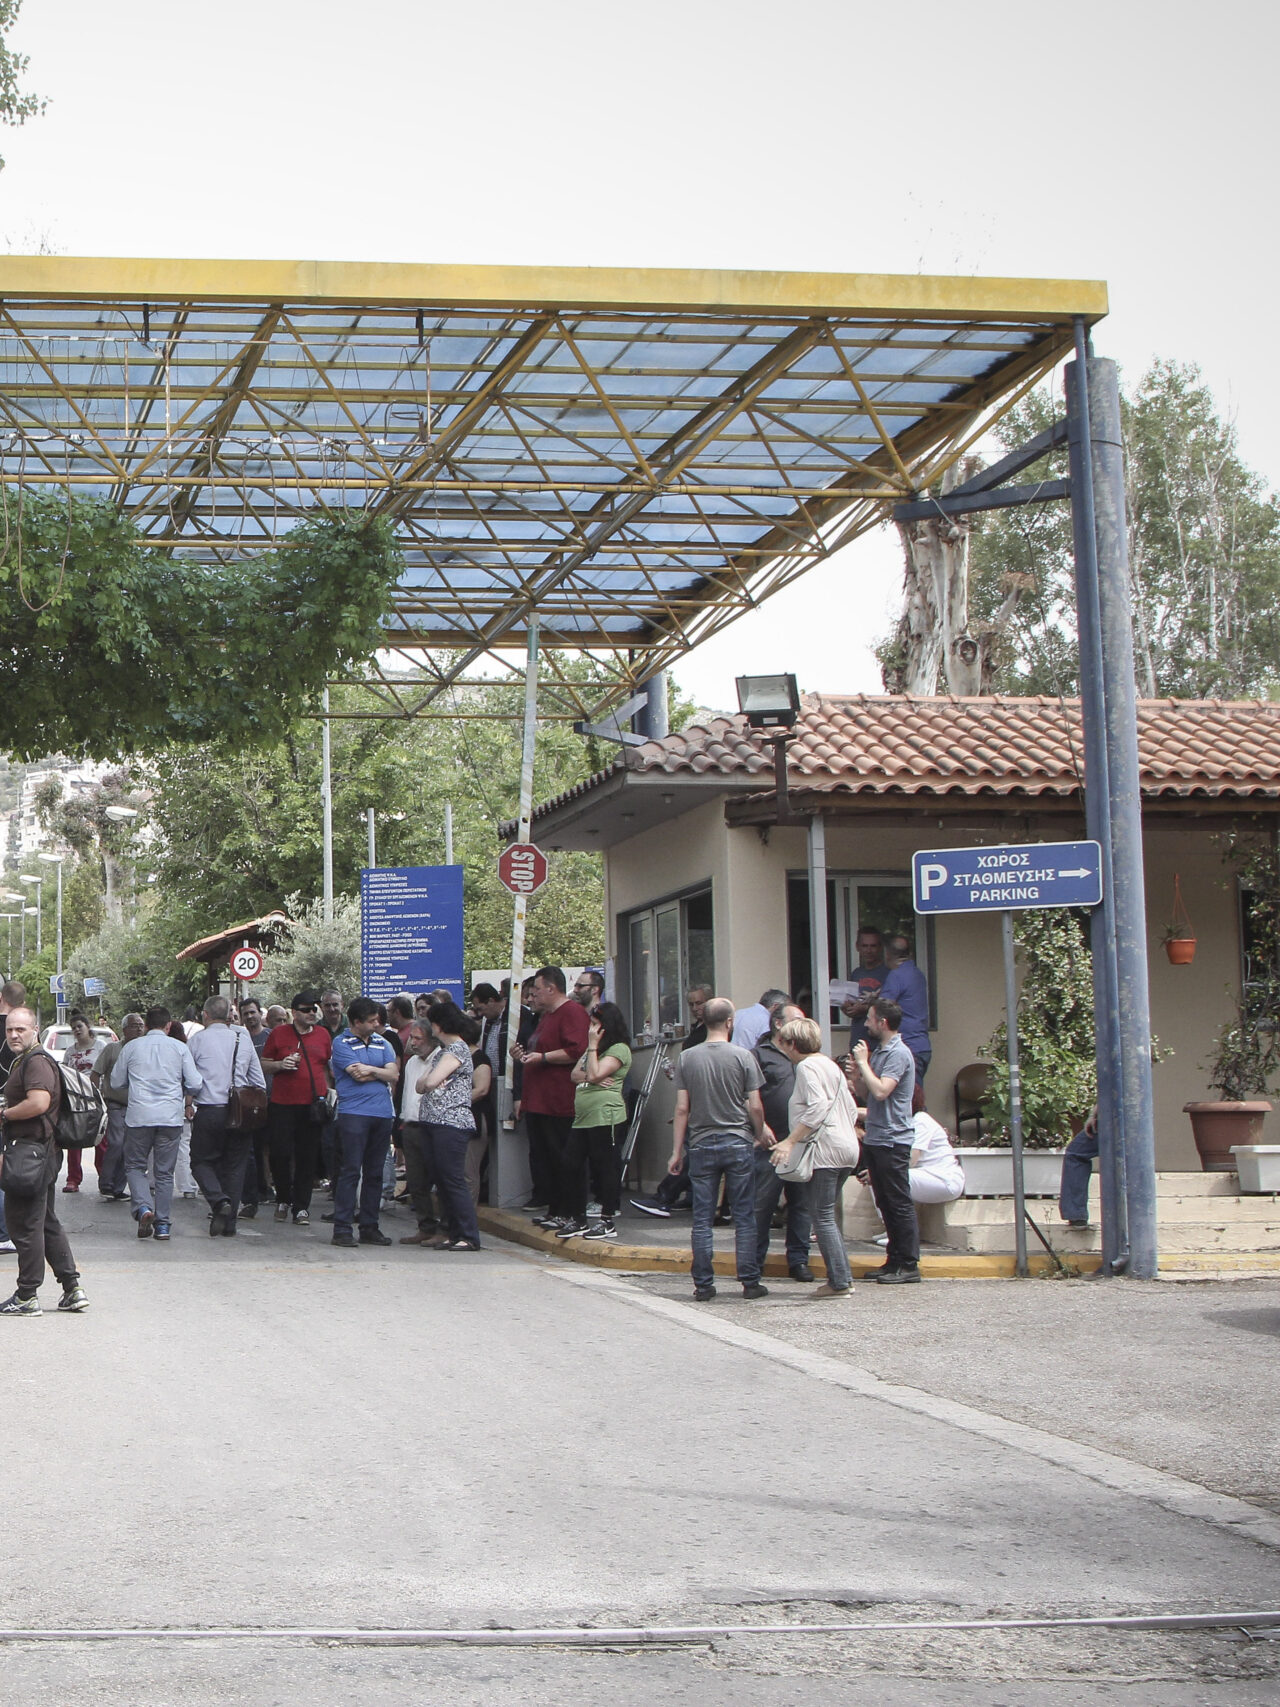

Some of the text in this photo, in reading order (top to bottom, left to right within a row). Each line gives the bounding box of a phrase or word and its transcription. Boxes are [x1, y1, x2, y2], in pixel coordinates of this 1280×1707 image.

[977, 853, 1030, 869] ΧΩΡΟΣ
[511, 850, 535, 890] STOP
[953, 869, 1056, 887] ΣΤΑΘΜΕΥΣΗΣ
[920, 864, 948, 901] P
[970, 887, 1039, 903] PARKING
[238, 958, 256, 970] 20
